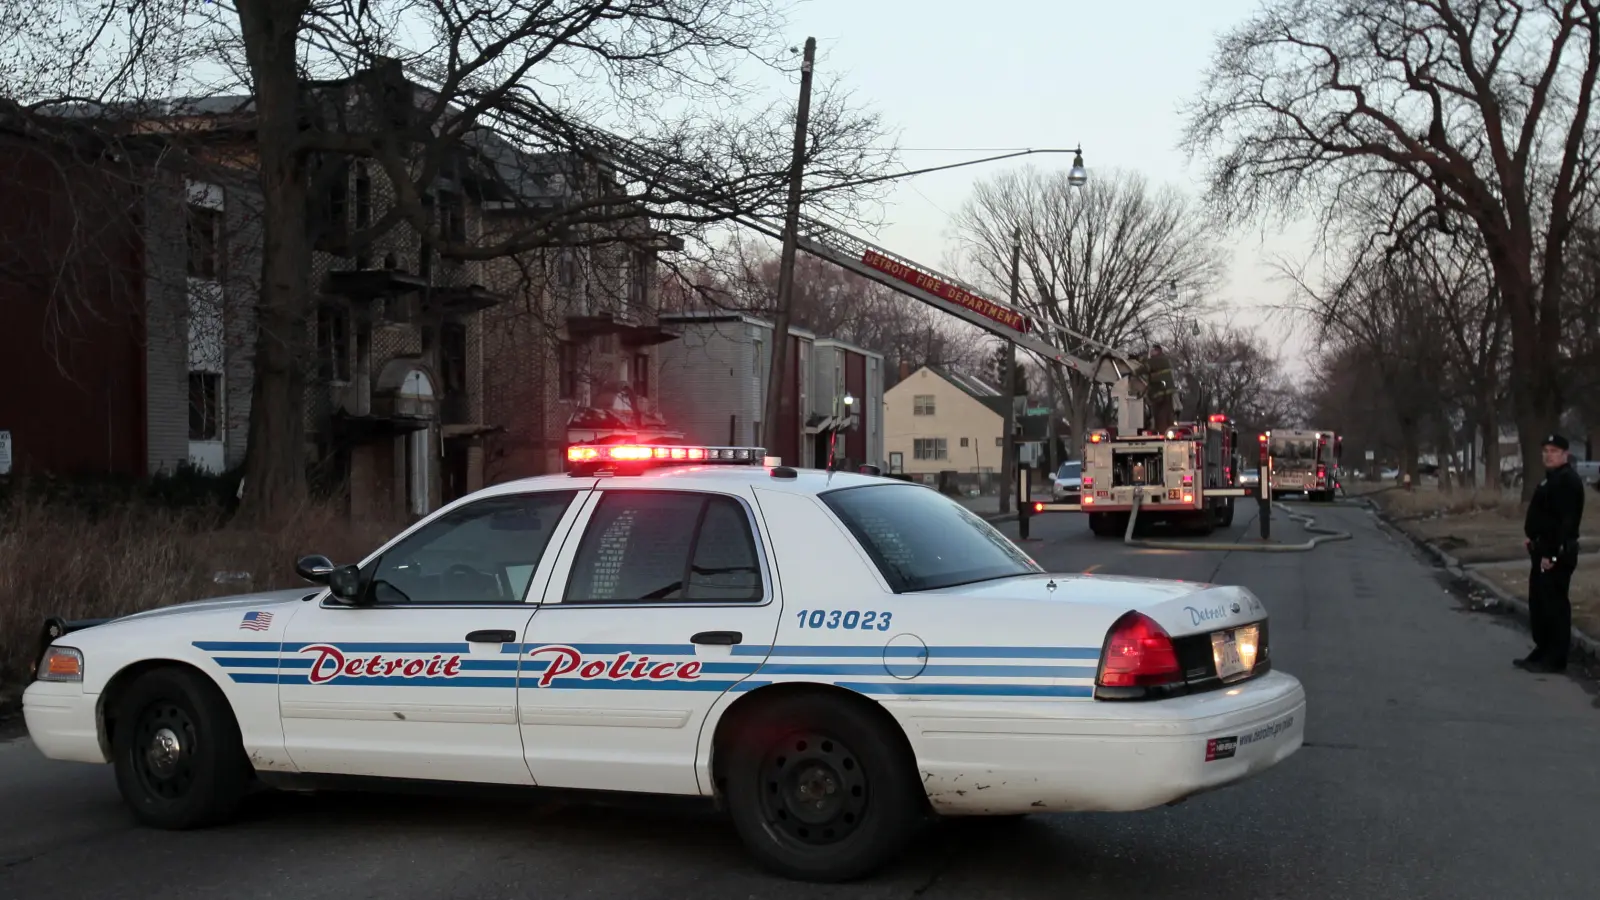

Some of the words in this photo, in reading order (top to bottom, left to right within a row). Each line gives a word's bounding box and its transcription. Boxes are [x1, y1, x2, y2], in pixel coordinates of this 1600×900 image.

[865, 254, 911, 278] DETROIT
[916, 275, 941, 293] FIRE
[947, 288, 1023, 327] DEPARTMENT
[796, 609, 893, 632] 103023
[1183, 605, 1227, 627] Detroit
[298, 643, 462, 685] Detroit
[529, 645, 703, 688] Police
